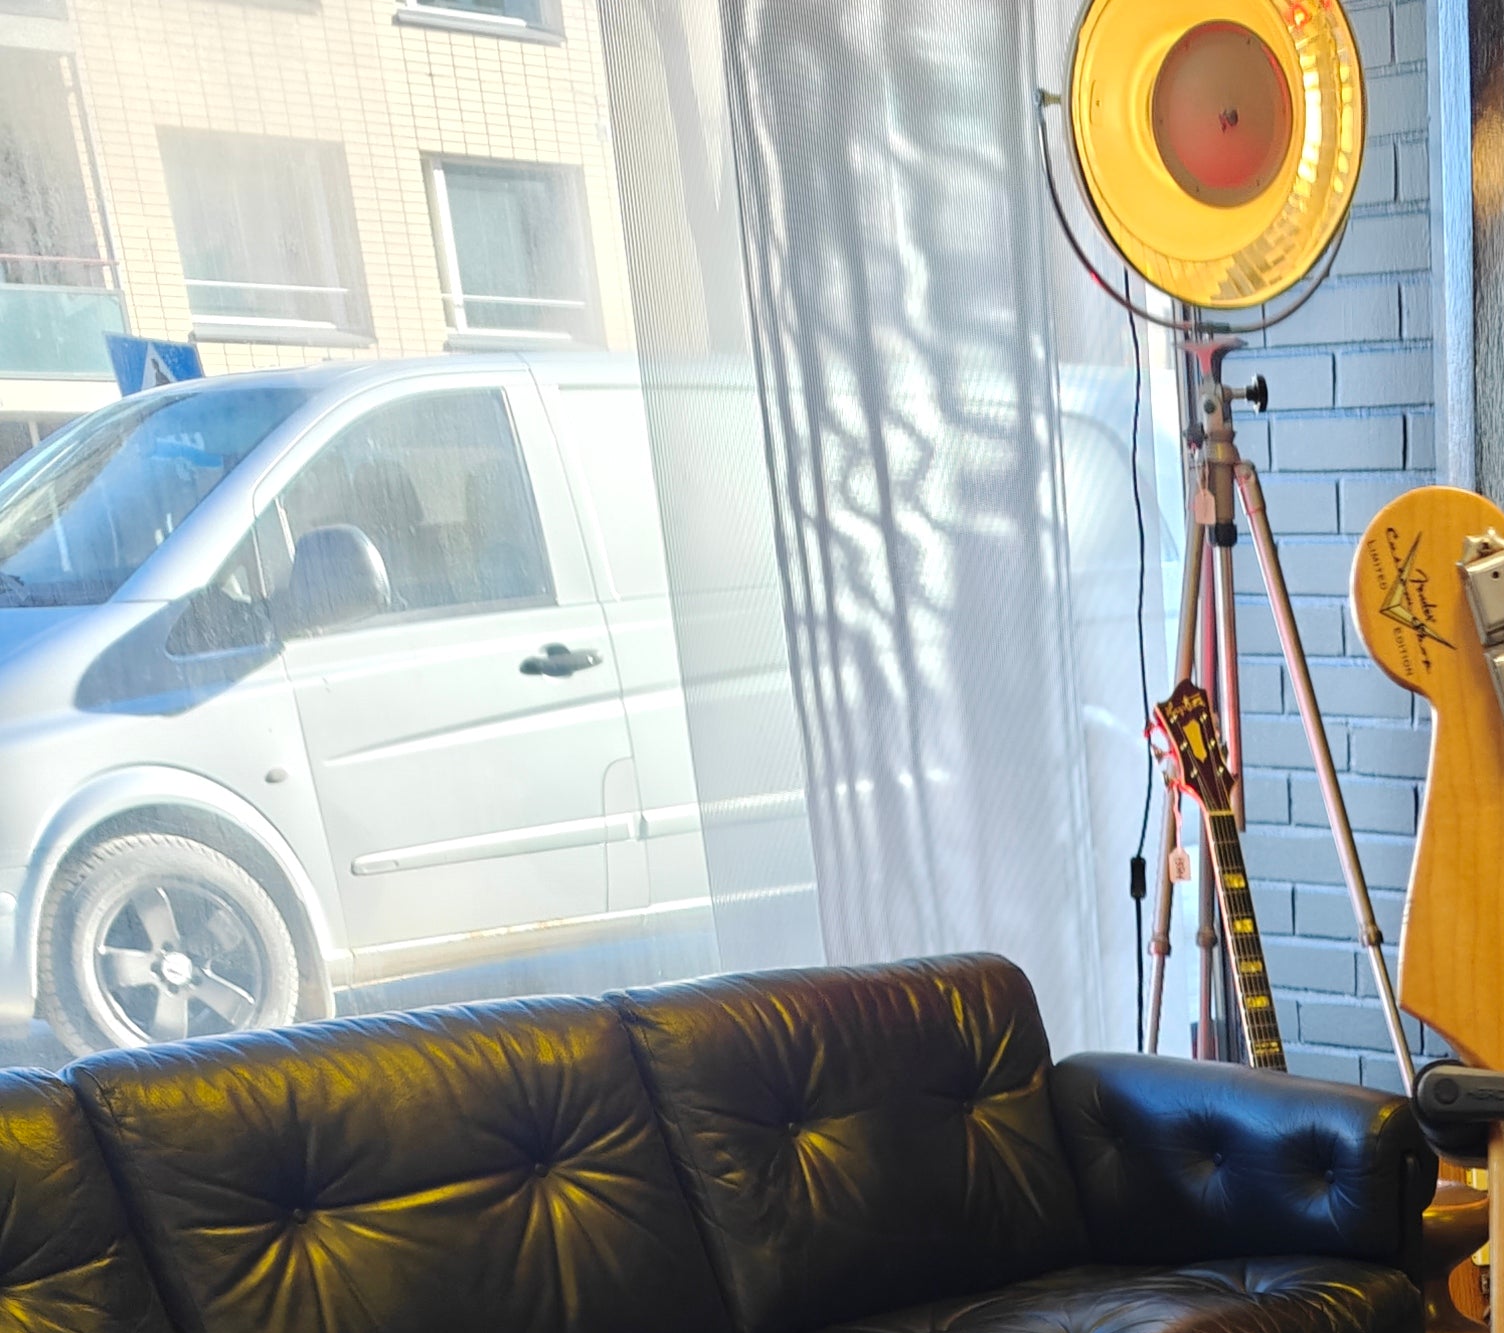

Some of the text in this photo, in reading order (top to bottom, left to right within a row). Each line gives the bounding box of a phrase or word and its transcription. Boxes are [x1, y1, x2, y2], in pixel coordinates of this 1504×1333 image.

[1367, 539, 1415, 677] LIMITED EDITION
[1409, 568, 1438, 623] Fender
